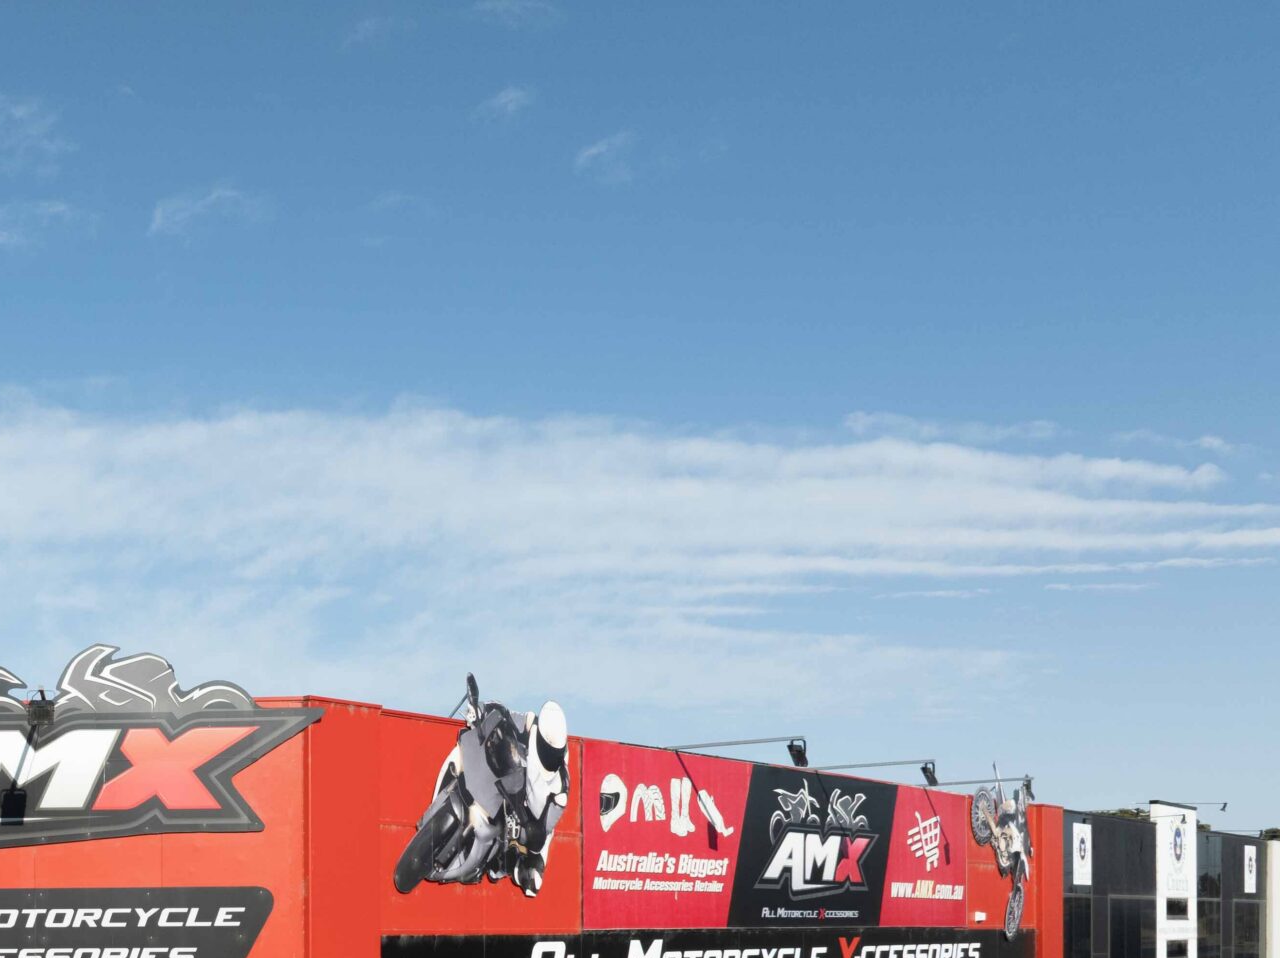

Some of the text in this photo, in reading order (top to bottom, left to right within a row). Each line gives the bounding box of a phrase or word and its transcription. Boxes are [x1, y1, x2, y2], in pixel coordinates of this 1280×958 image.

[596, 850, 729, 878] Australia's Biggest
[762, 832, 871, 891] AMX
[593, 877, 724, 892] Motorcycle Accessories Retailer
[891, 880, 964, 900] www.AMX.com.au
